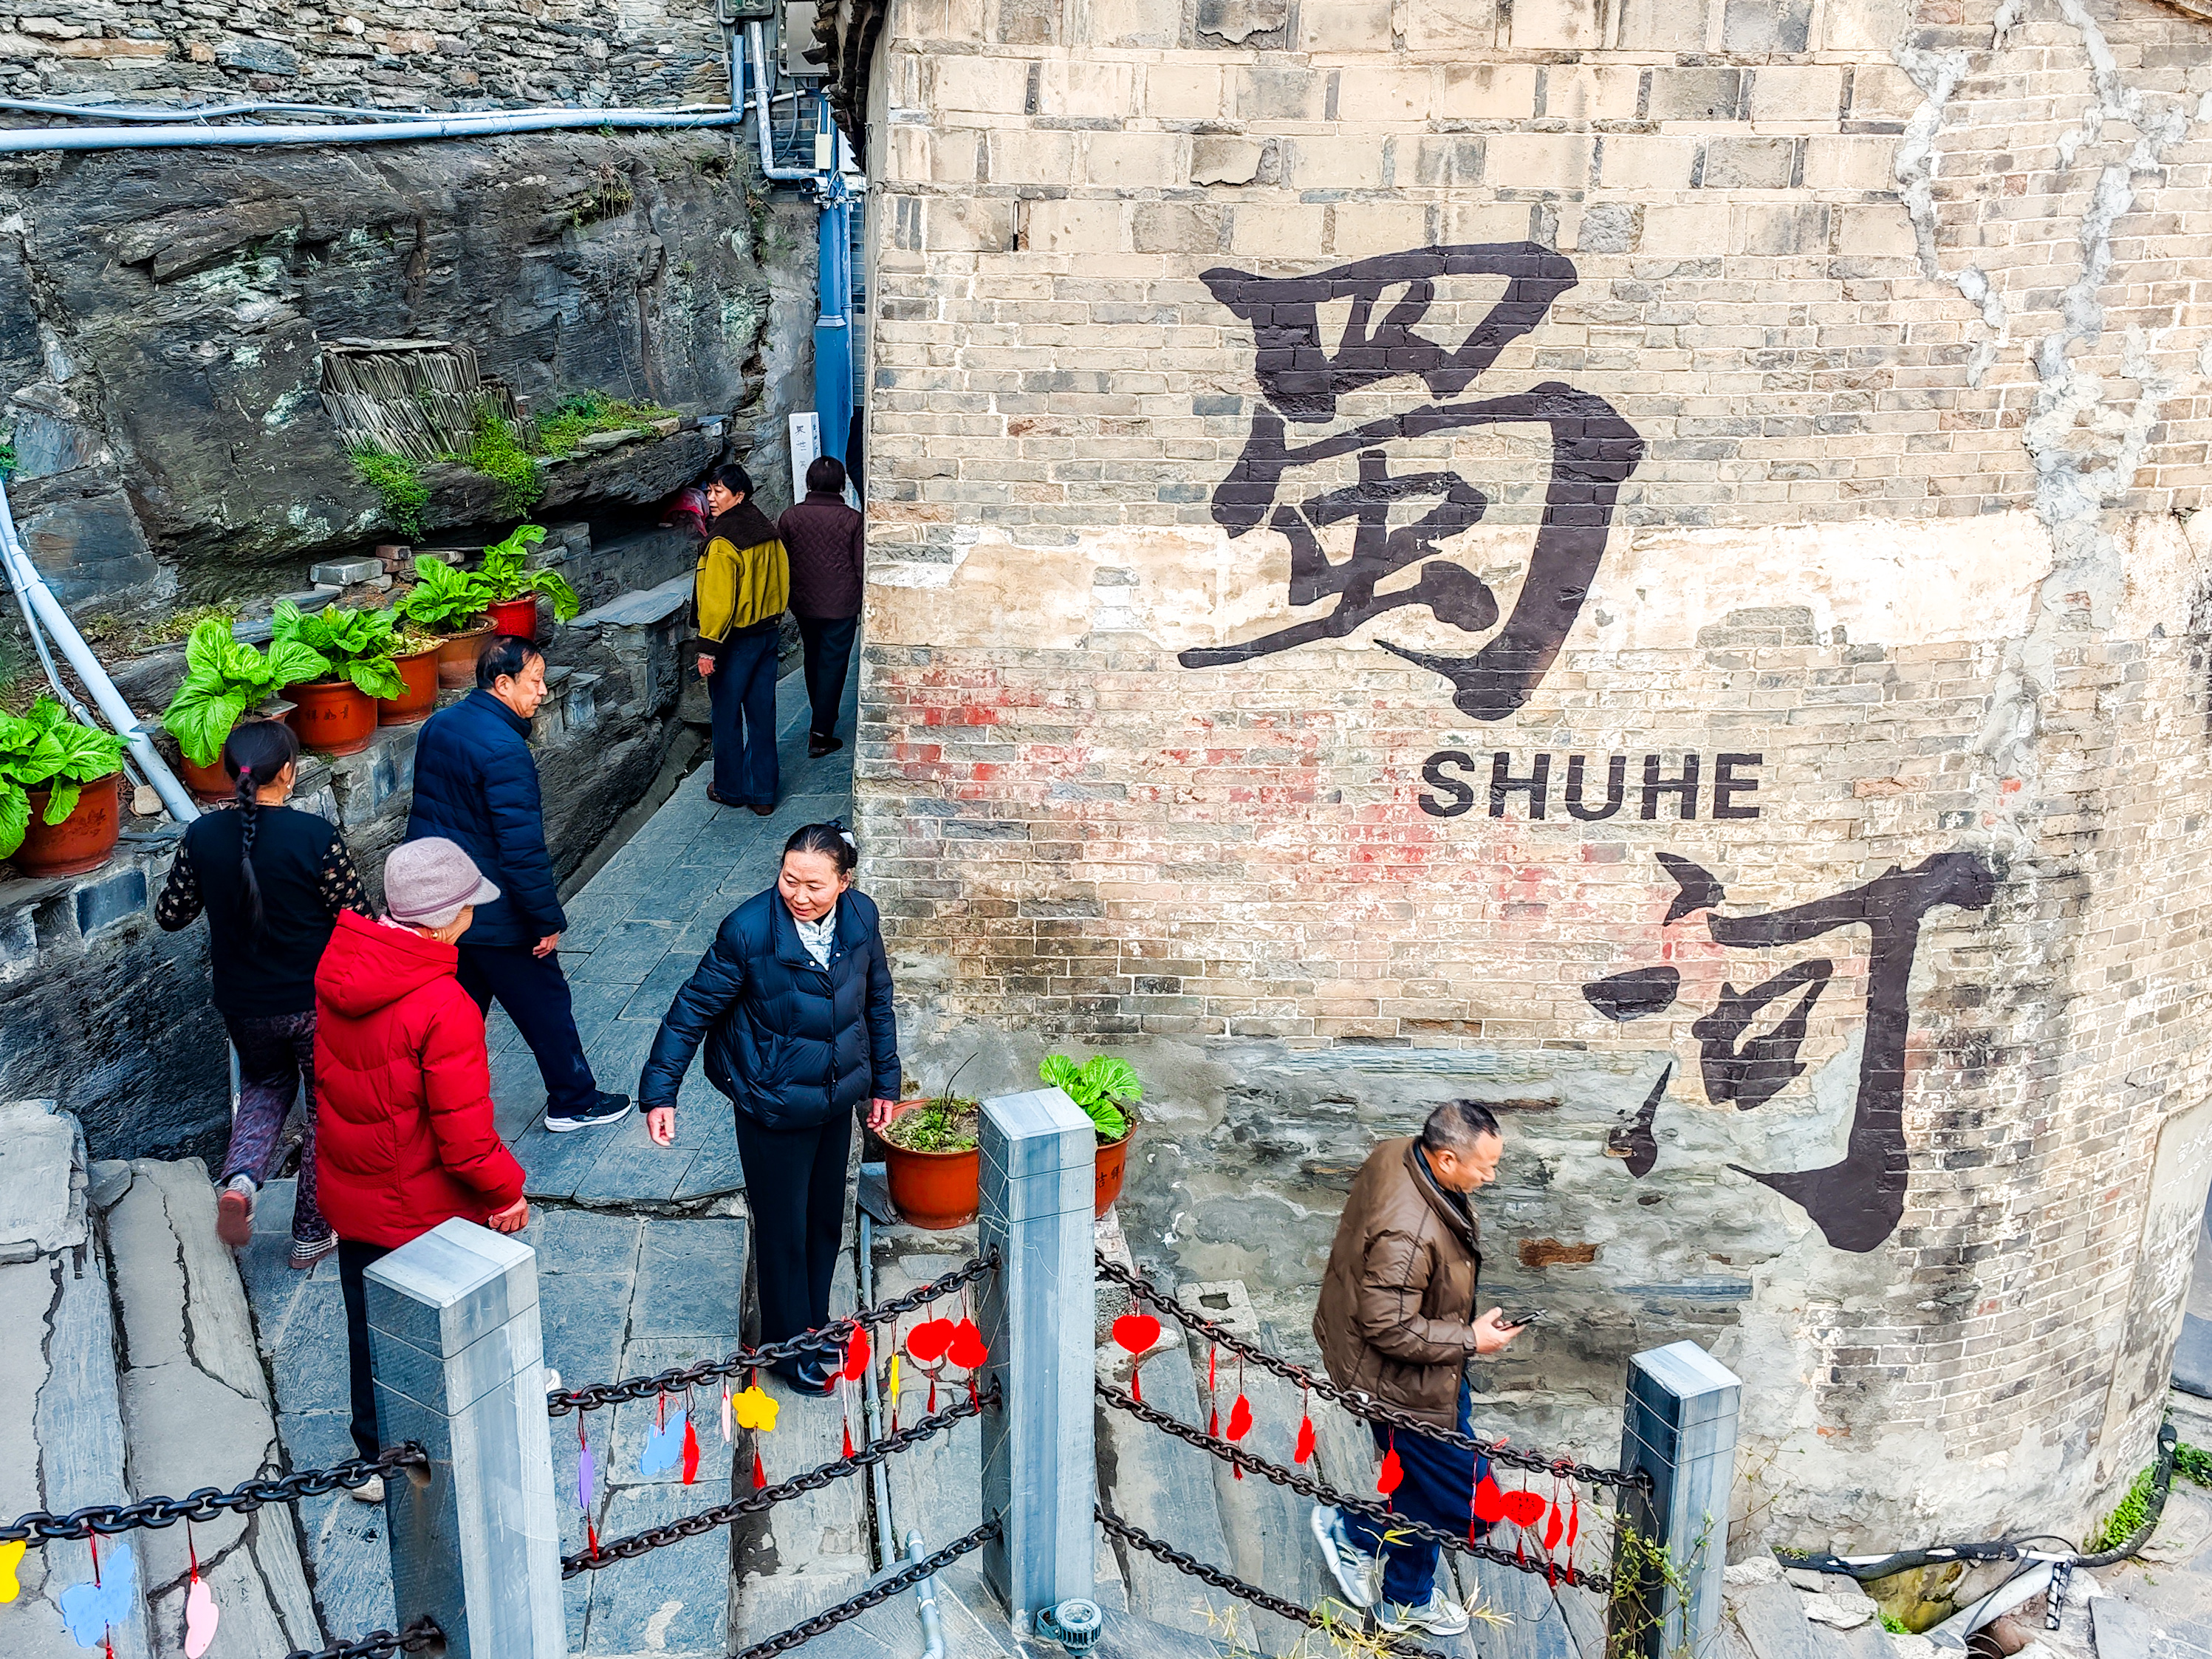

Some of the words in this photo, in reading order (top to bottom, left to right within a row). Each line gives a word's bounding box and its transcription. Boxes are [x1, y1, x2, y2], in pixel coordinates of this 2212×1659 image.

[1179, 241, 1646, 721] 蜀
[1418, 750, 1763, 821] SHUHE
[1581, 851, 1996, 1253] 河
